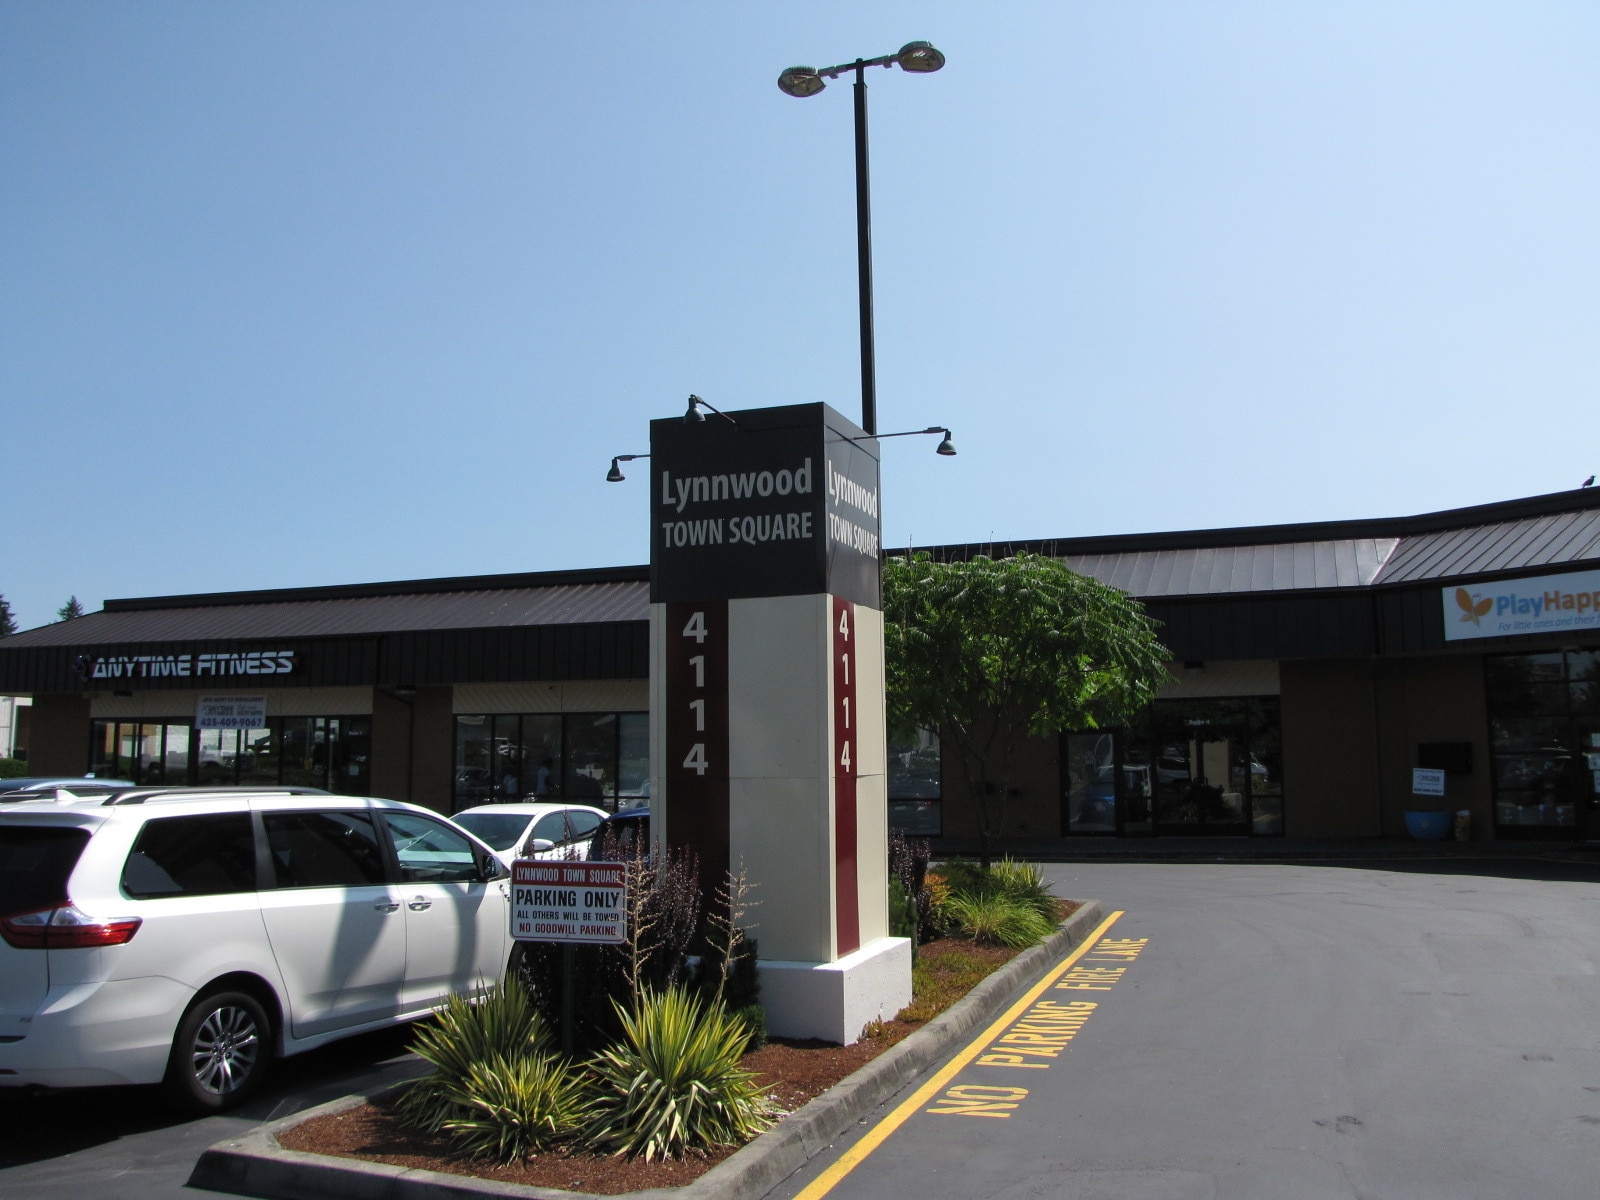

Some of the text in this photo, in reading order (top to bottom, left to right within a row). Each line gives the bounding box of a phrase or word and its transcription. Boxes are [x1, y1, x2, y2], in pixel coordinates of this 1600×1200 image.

[662, 457, 813, 514] Lynnwood
[828, 459, 878, 520] Lynnwood
[662, 511, 813, 548] TOWN SQUARE
[829, 512, 878, 560] TOWN SQUARE
[1498, 622, 1511, 632] For
[1513, 620, 1532, 630] little
[1533, 620, 1554, 629] ones
[1555, 617, 1573, 627] and
[1574, 615, 1594, 625] their
[92, 651, 294, 678] ANYTIME FITNESS
[200, 718, 262, 727] 425-409-9067
[516, 867, 621, 884] LYNNWOOD TOWN SQUARE
[516, 889, 620, 908] PARKING ONLY
[517, 910, 619, 921] ALL OTHERS WILL BE TOWED
[519, 923, 616, 936] NO GOODWILL PARKING
[925, 938, 1149, 1118] NO PARKING FIRE LANE
